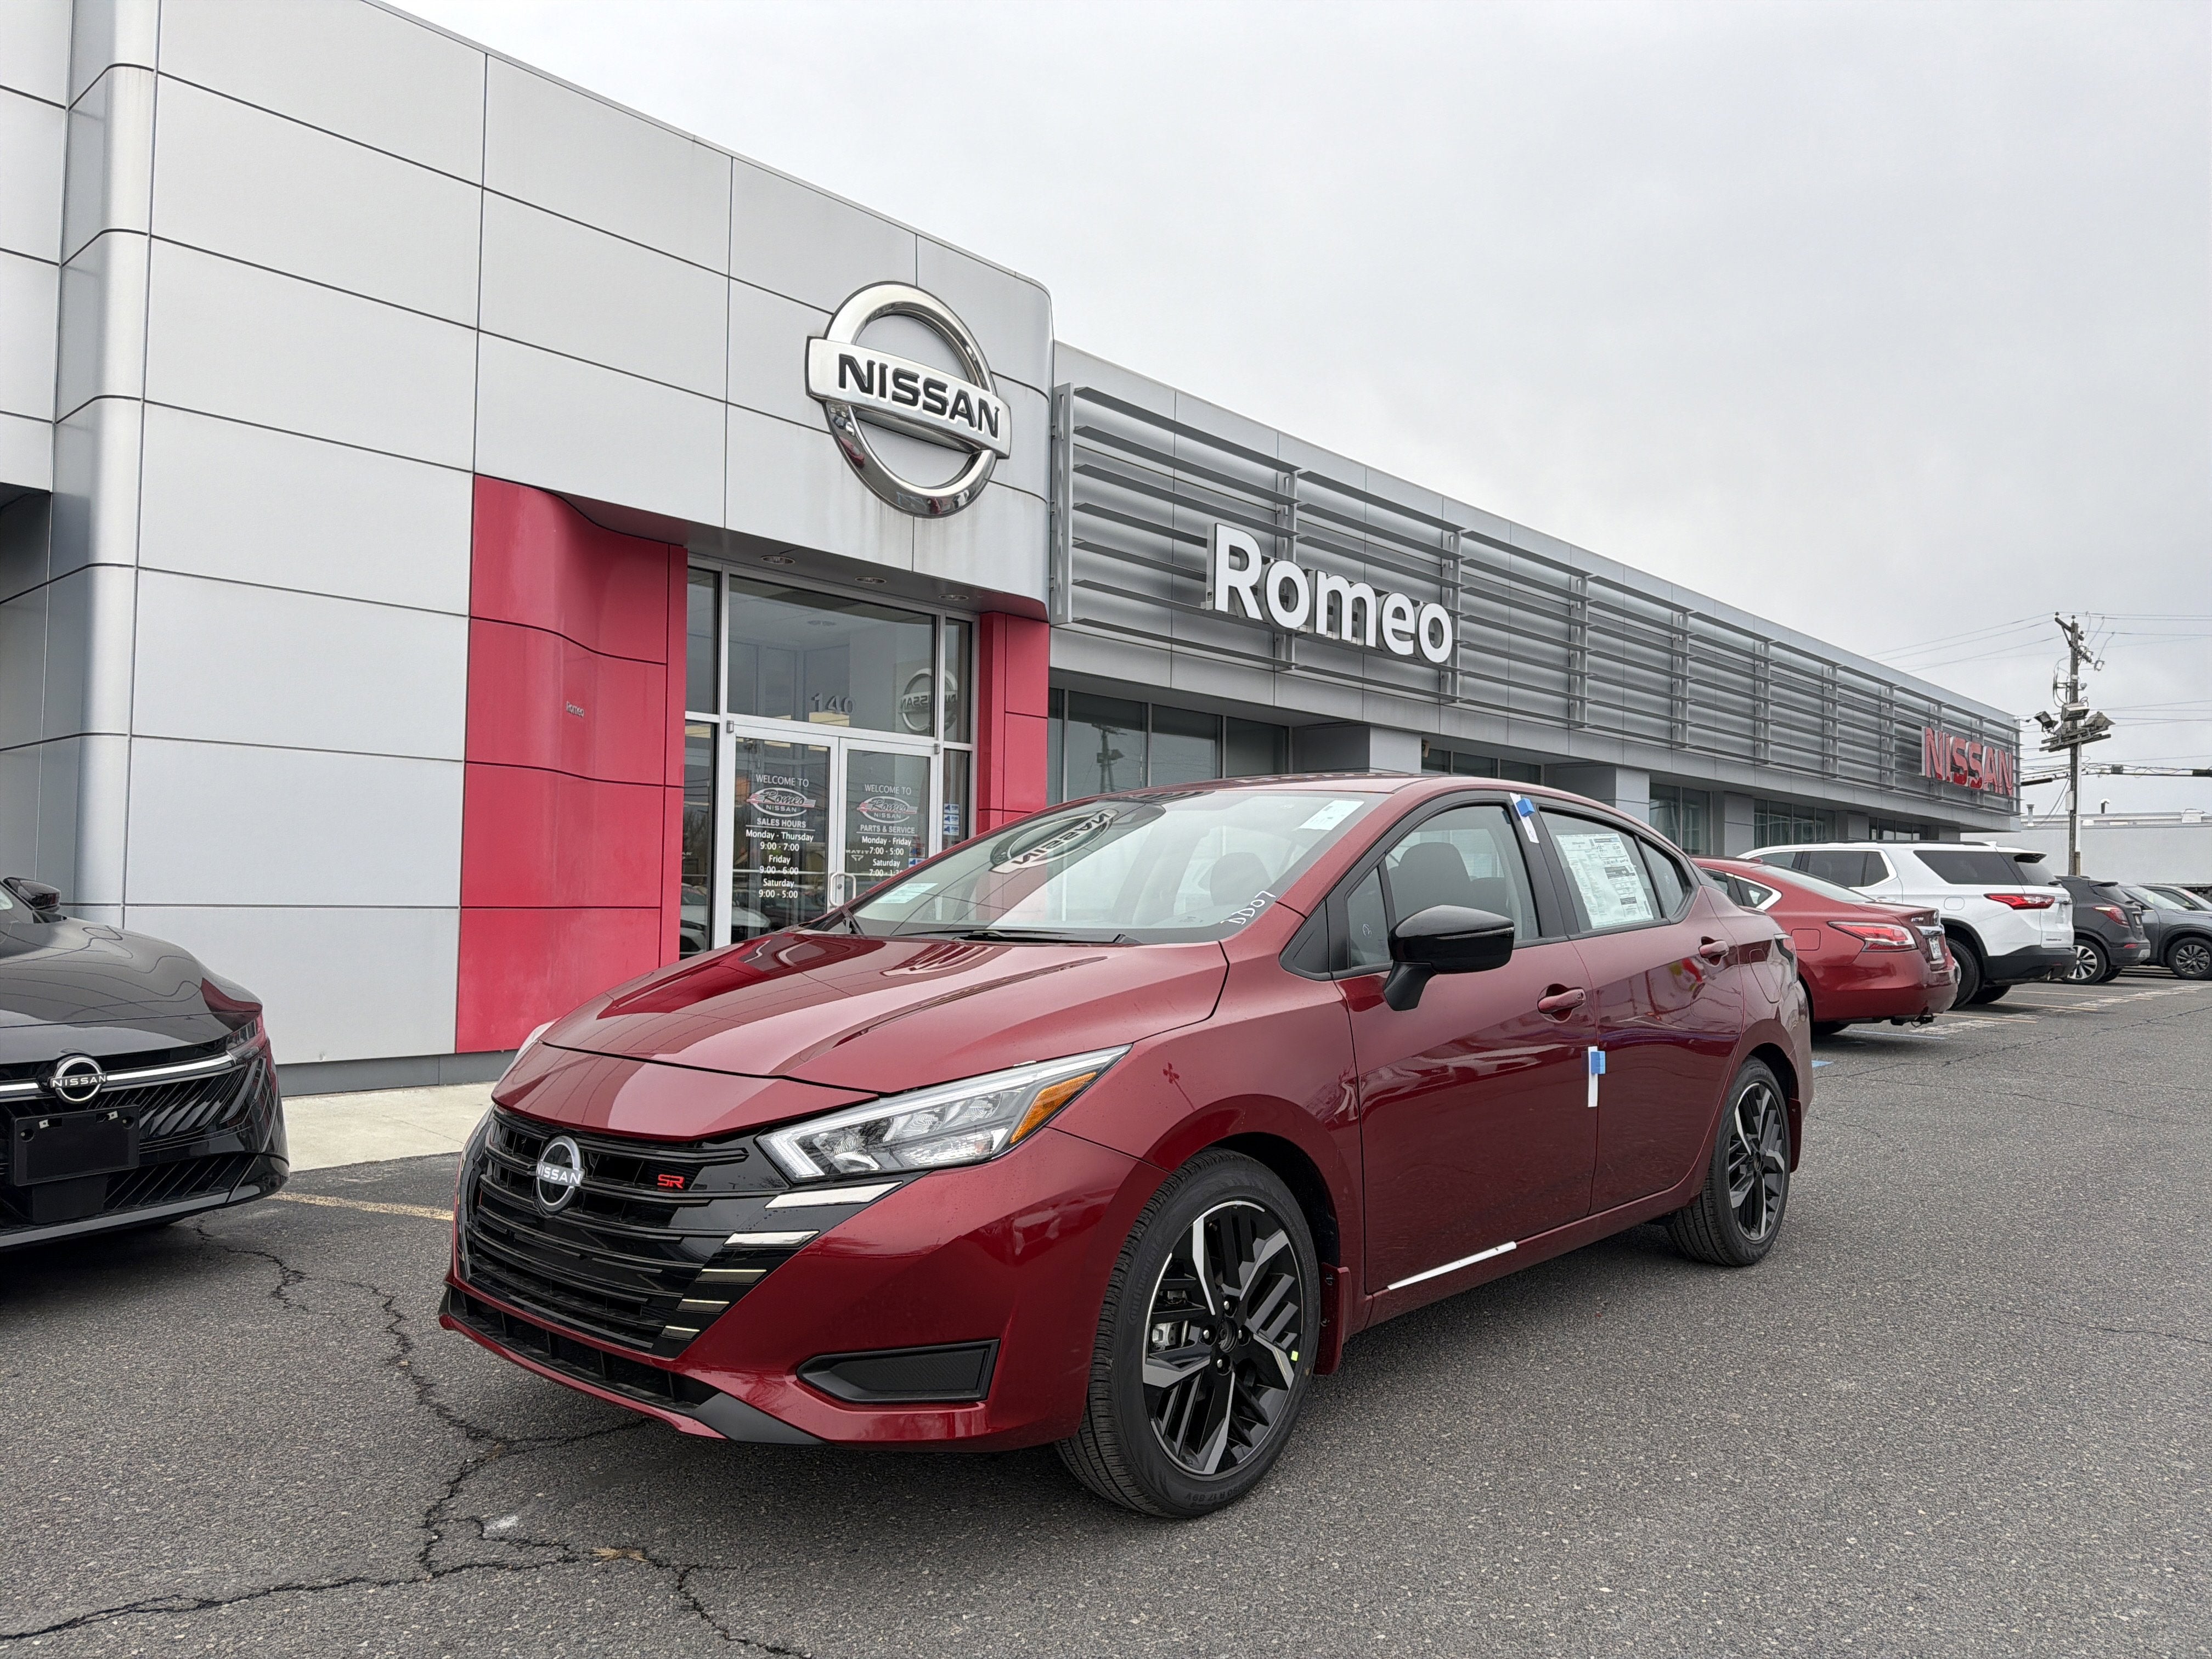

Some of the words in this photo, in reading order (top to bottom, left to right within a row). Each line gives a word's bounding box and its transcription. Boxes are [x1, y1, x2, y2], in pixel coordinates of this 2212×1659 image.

[838, 353, 1000, 439] NISSAN
[1214, 523, 1453, 664] Romeo
[566, 701, 584, 718] Romeo
[811, 693, 856, 714] 140
[1923, 727, 2014, 797] NISSAN
[756, 774, 795, 786] WELCOME
[797, 778, 809, 787] TO
[865, 784, 899, 794] WELCOME
[901, 787, 911, 795] TO
[762, 789, 806, 805] Romeo
[871, 798, 909, 811] Romeo
[757, 817, 780, 827] SALES
[781, 819, 806, 828] HOURS
[746, 829, 775, 839] Monday
[781, 832, 814, 843] Thursday
[889, 826, 915, 834] SERVICE
[760, 842, 777, 850] 9:00
[783, 843, 800, 851] 7:00
[862, 836, 887, 845] Monday
[893, 837, 912, 847] Friday
[870, 847, 884, 855] 7:00
[890, 848, 904, 856] 5:00
[769, 854, 791, 865] Friday
[873, 859, 900, 868] Saturday
[759, 865, 776, 874] 9:00
[782, 867, 799, 875] 6:00
[763, 878, 794, 888] Saturday
[759, 889, 775, 898] 9:00
[782, 890, 798, 899] 5:00
[52, 1075, 105, 1087] NISSAN
[536, 1163, 581, 1184] NISSAN
[657, 1174, 685, 1189] SR
